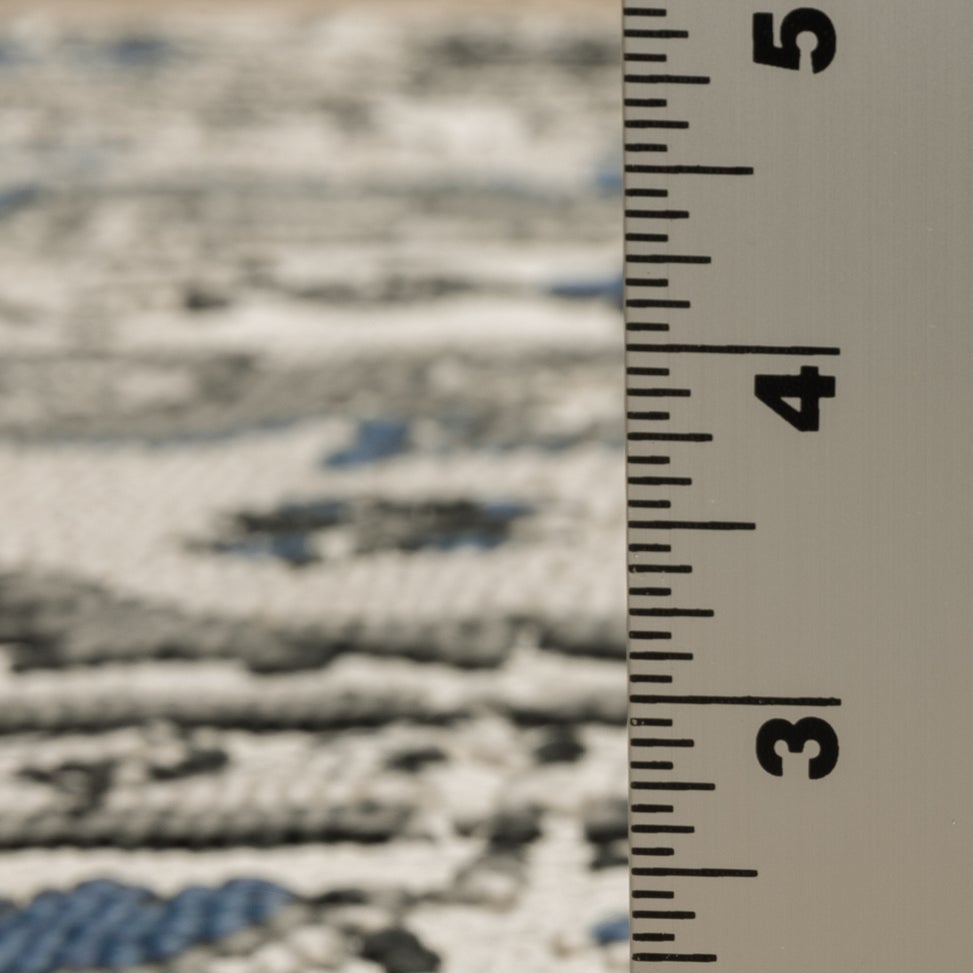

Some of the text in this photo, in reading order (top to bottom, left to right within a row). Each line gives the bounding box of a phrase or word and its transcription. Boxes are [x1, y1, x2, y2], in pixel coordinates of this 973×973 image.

[752, 7, 837, 75] 5
[753, 365, 837, 433] 4
[755, 716, 840, 780] 3
